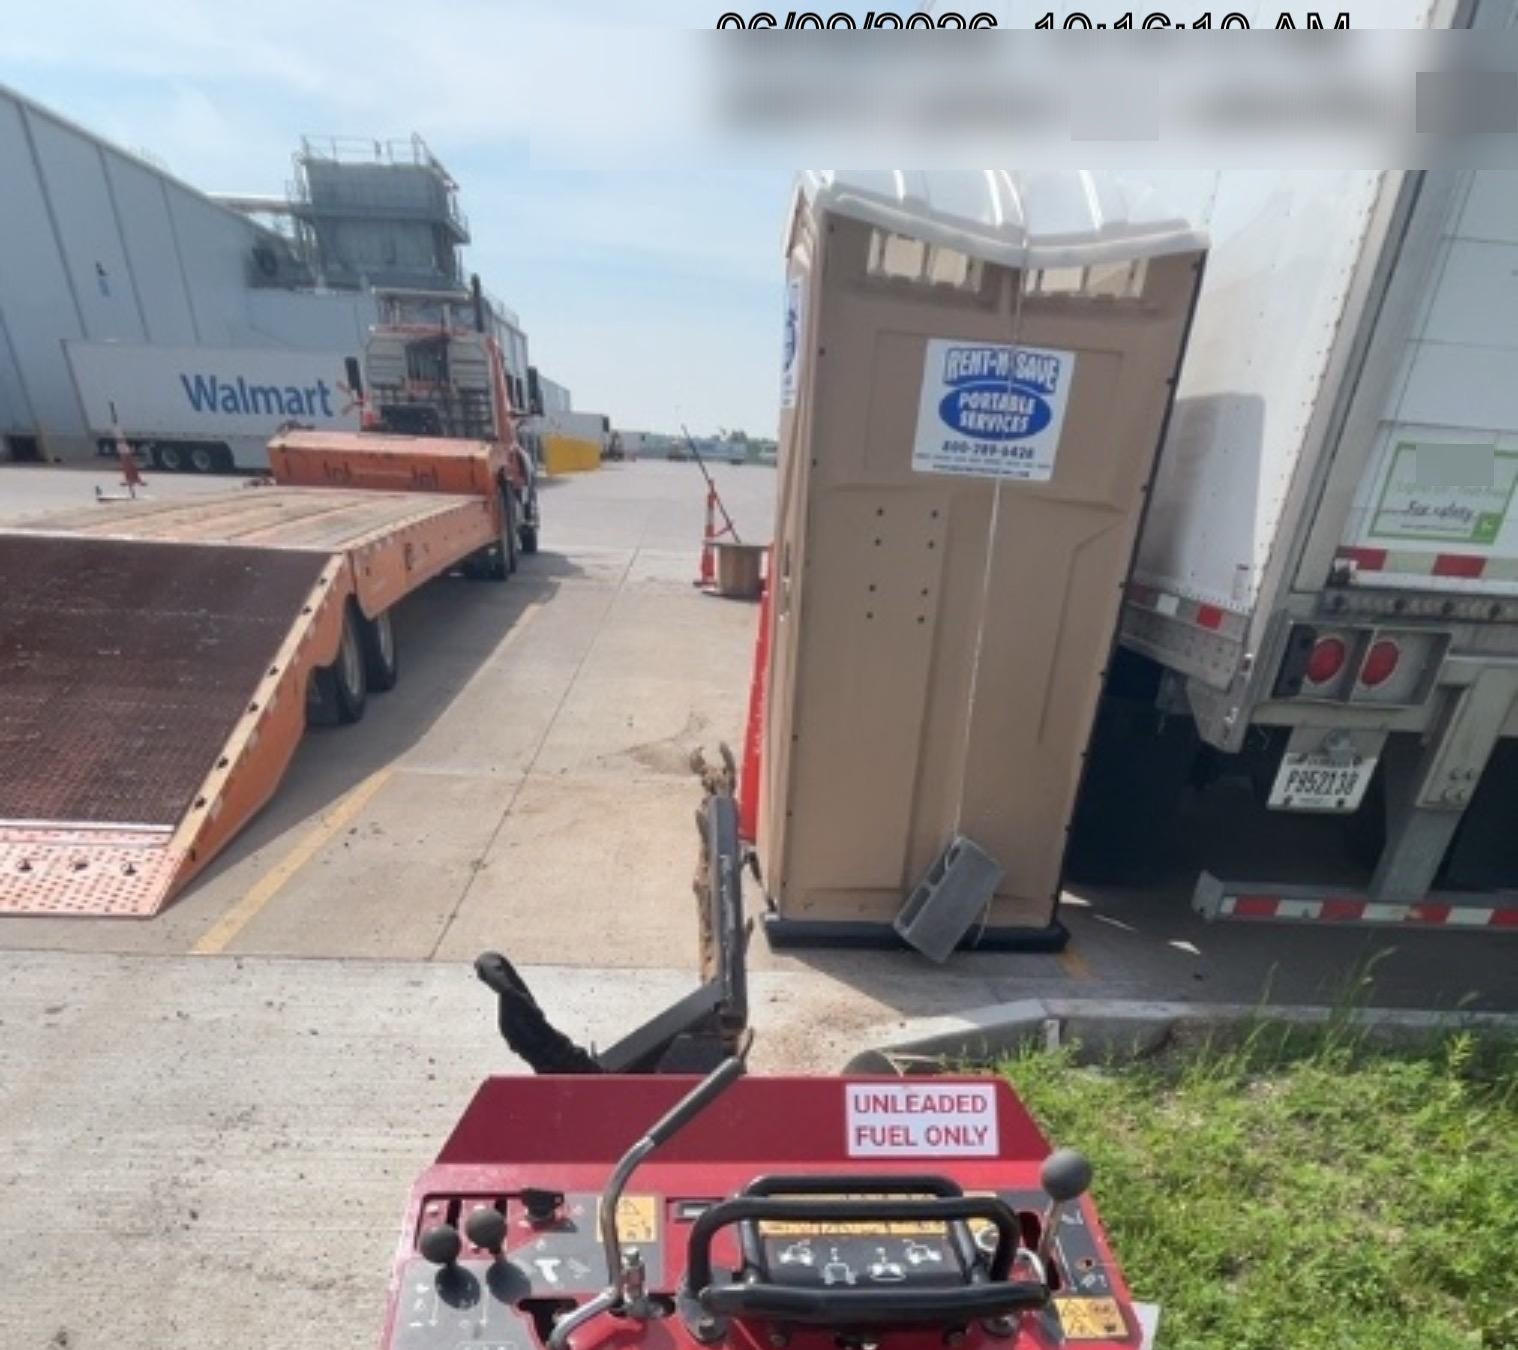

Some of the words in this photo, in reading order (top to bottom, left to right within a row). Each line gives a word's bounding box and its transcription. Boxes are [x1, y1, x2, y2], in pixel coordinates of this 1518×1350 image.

[1015, 352, 1059, 392] SAVE
[180, 374, 333, 417] Walmart
[958, 391, 1036, 415] PORTABLE
[959, 410, 1030, 433] SERVICES
[854, 1094, 988, 1114] UNLEADED
[855, 1125, 918, 1147] FUEL
[924, 1124, 988, 1147] ONLY
